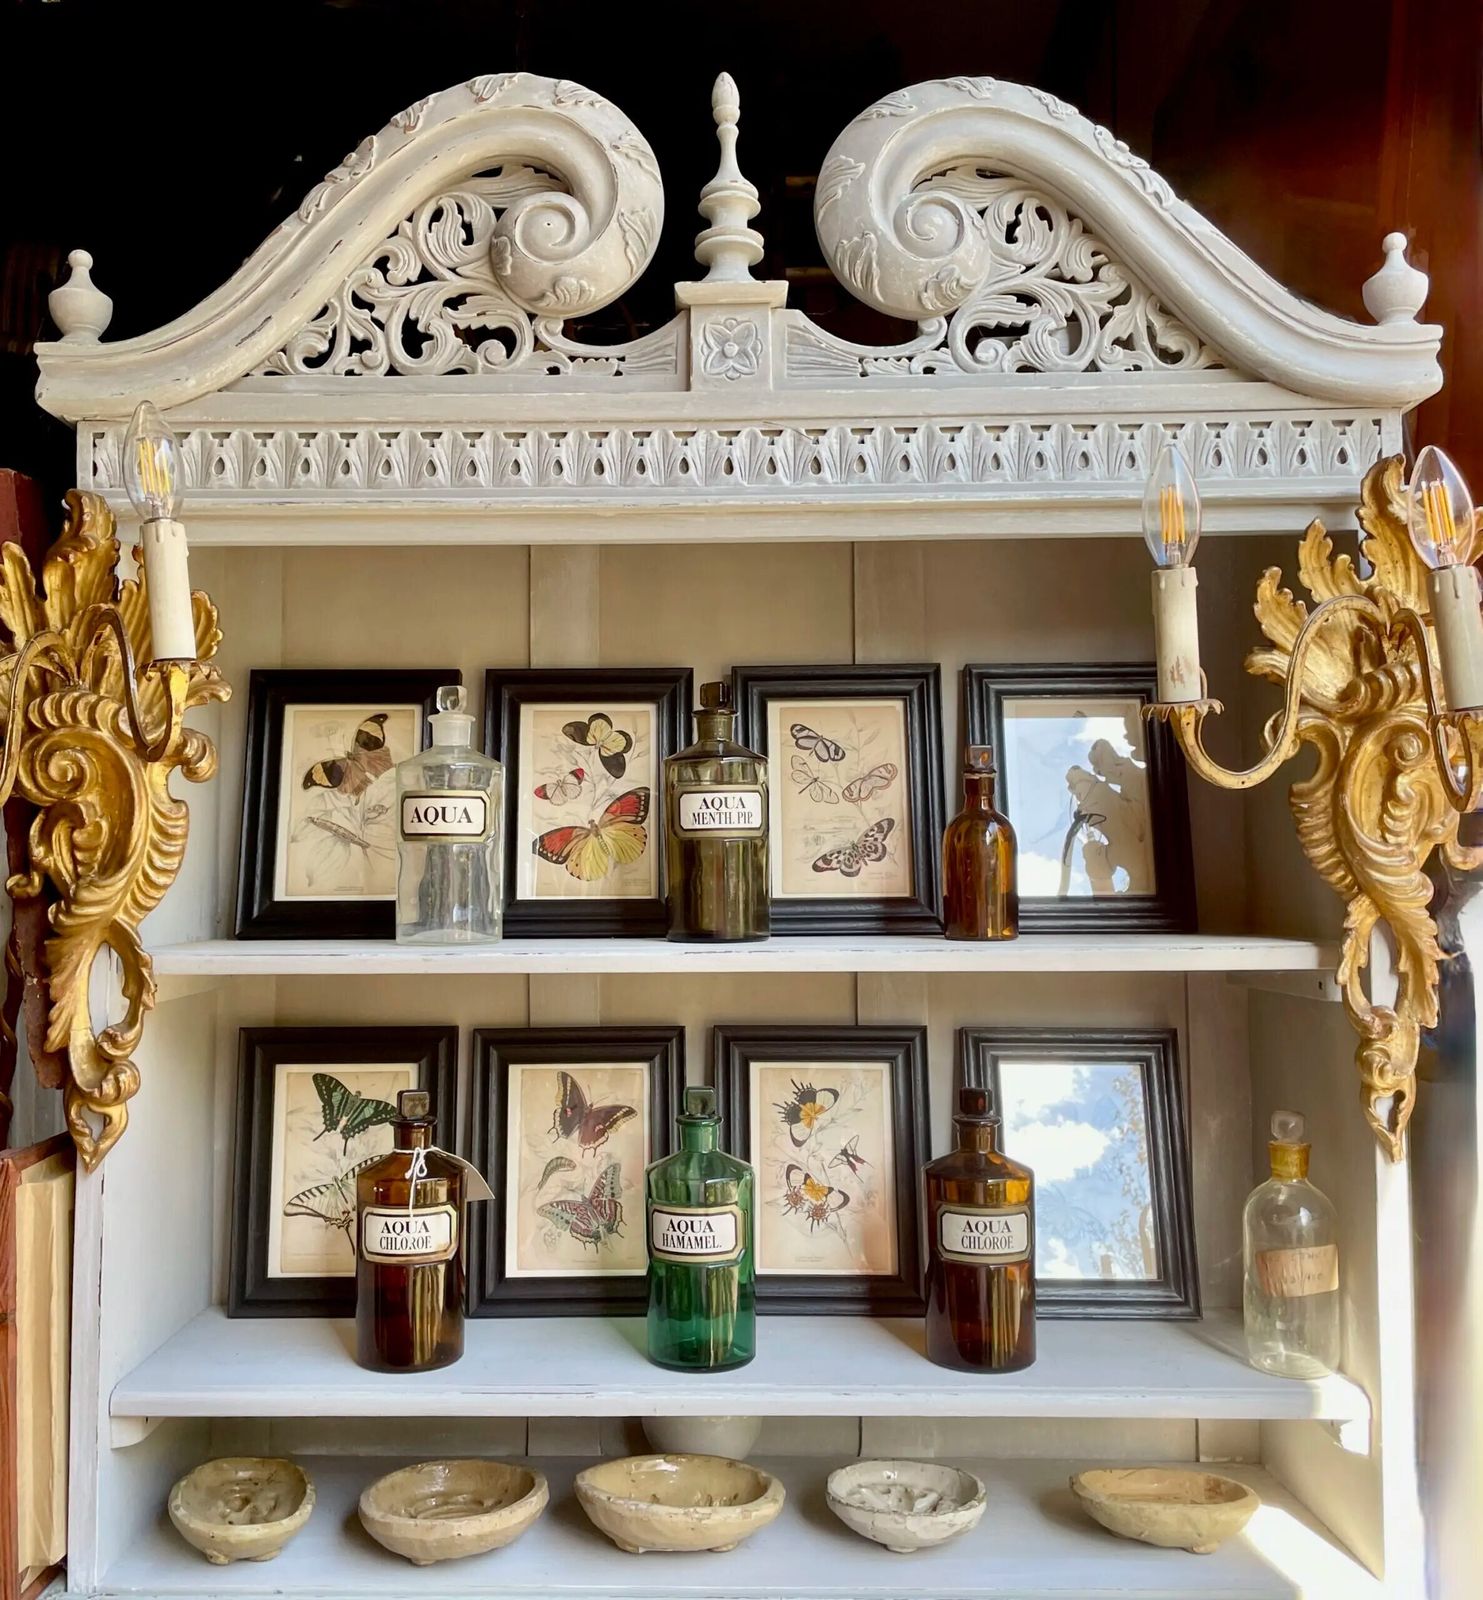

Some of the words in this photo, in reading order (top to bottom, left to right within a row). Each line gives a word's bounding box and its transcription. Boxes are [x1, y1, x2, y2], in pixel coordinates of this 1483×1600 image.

[699, 796, 746, 811] AQUA
[410, 806, 473, 826] AQUA
[381, 1220, 430, 1236] AQUA
[667, 1218, 715, 1235] AQUA
[962, 1219, 1012, 1235] AQUA
[662, 1233, 722, 1250] HAMAMEL.
